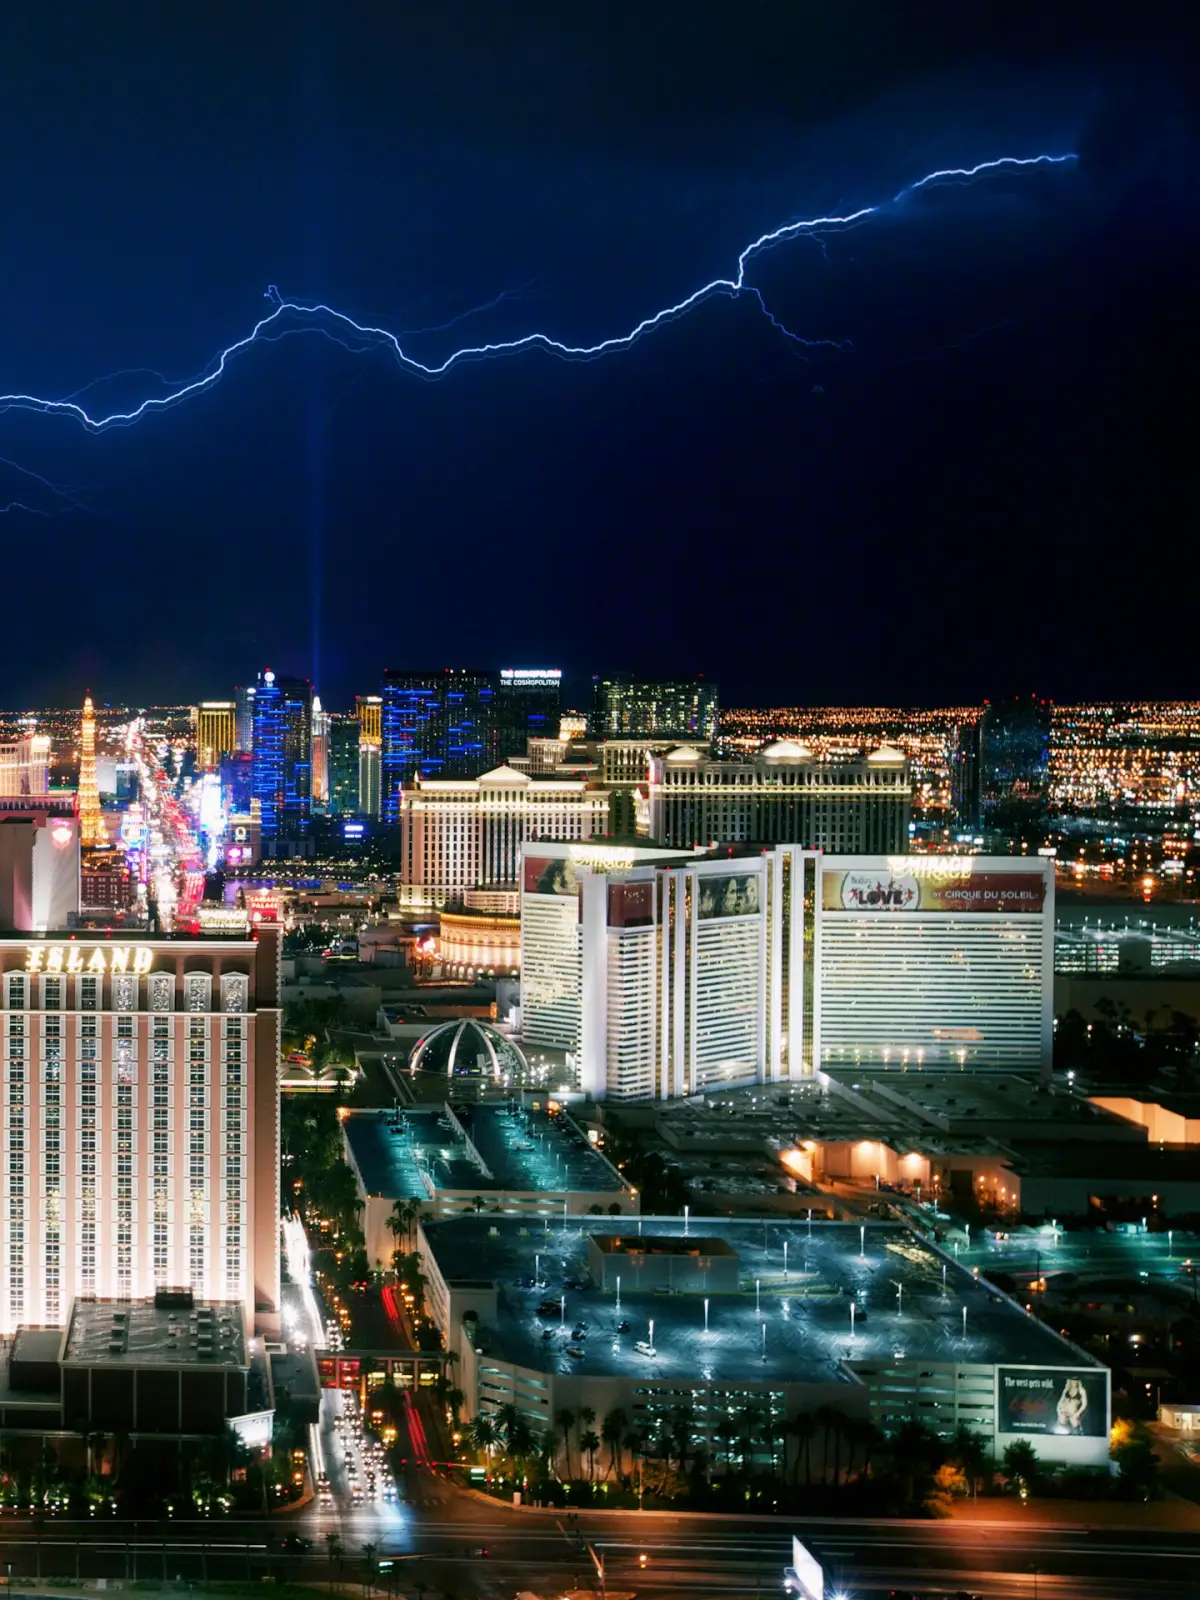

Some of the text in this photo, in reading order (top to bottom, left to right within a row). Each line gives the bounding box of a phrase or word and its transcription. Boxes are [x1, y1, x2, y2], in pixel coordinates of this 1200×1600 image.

[858, 891, 903, 905] LOVE
[945, 891, 981, 899] CIRQUE
[984, 891, 998, 899] DU
[1000, 891, 1034, 899] SOLEIL
[25, 946, 154, 974] ISLAND
[1004, 1377, 1015, 1387] The
